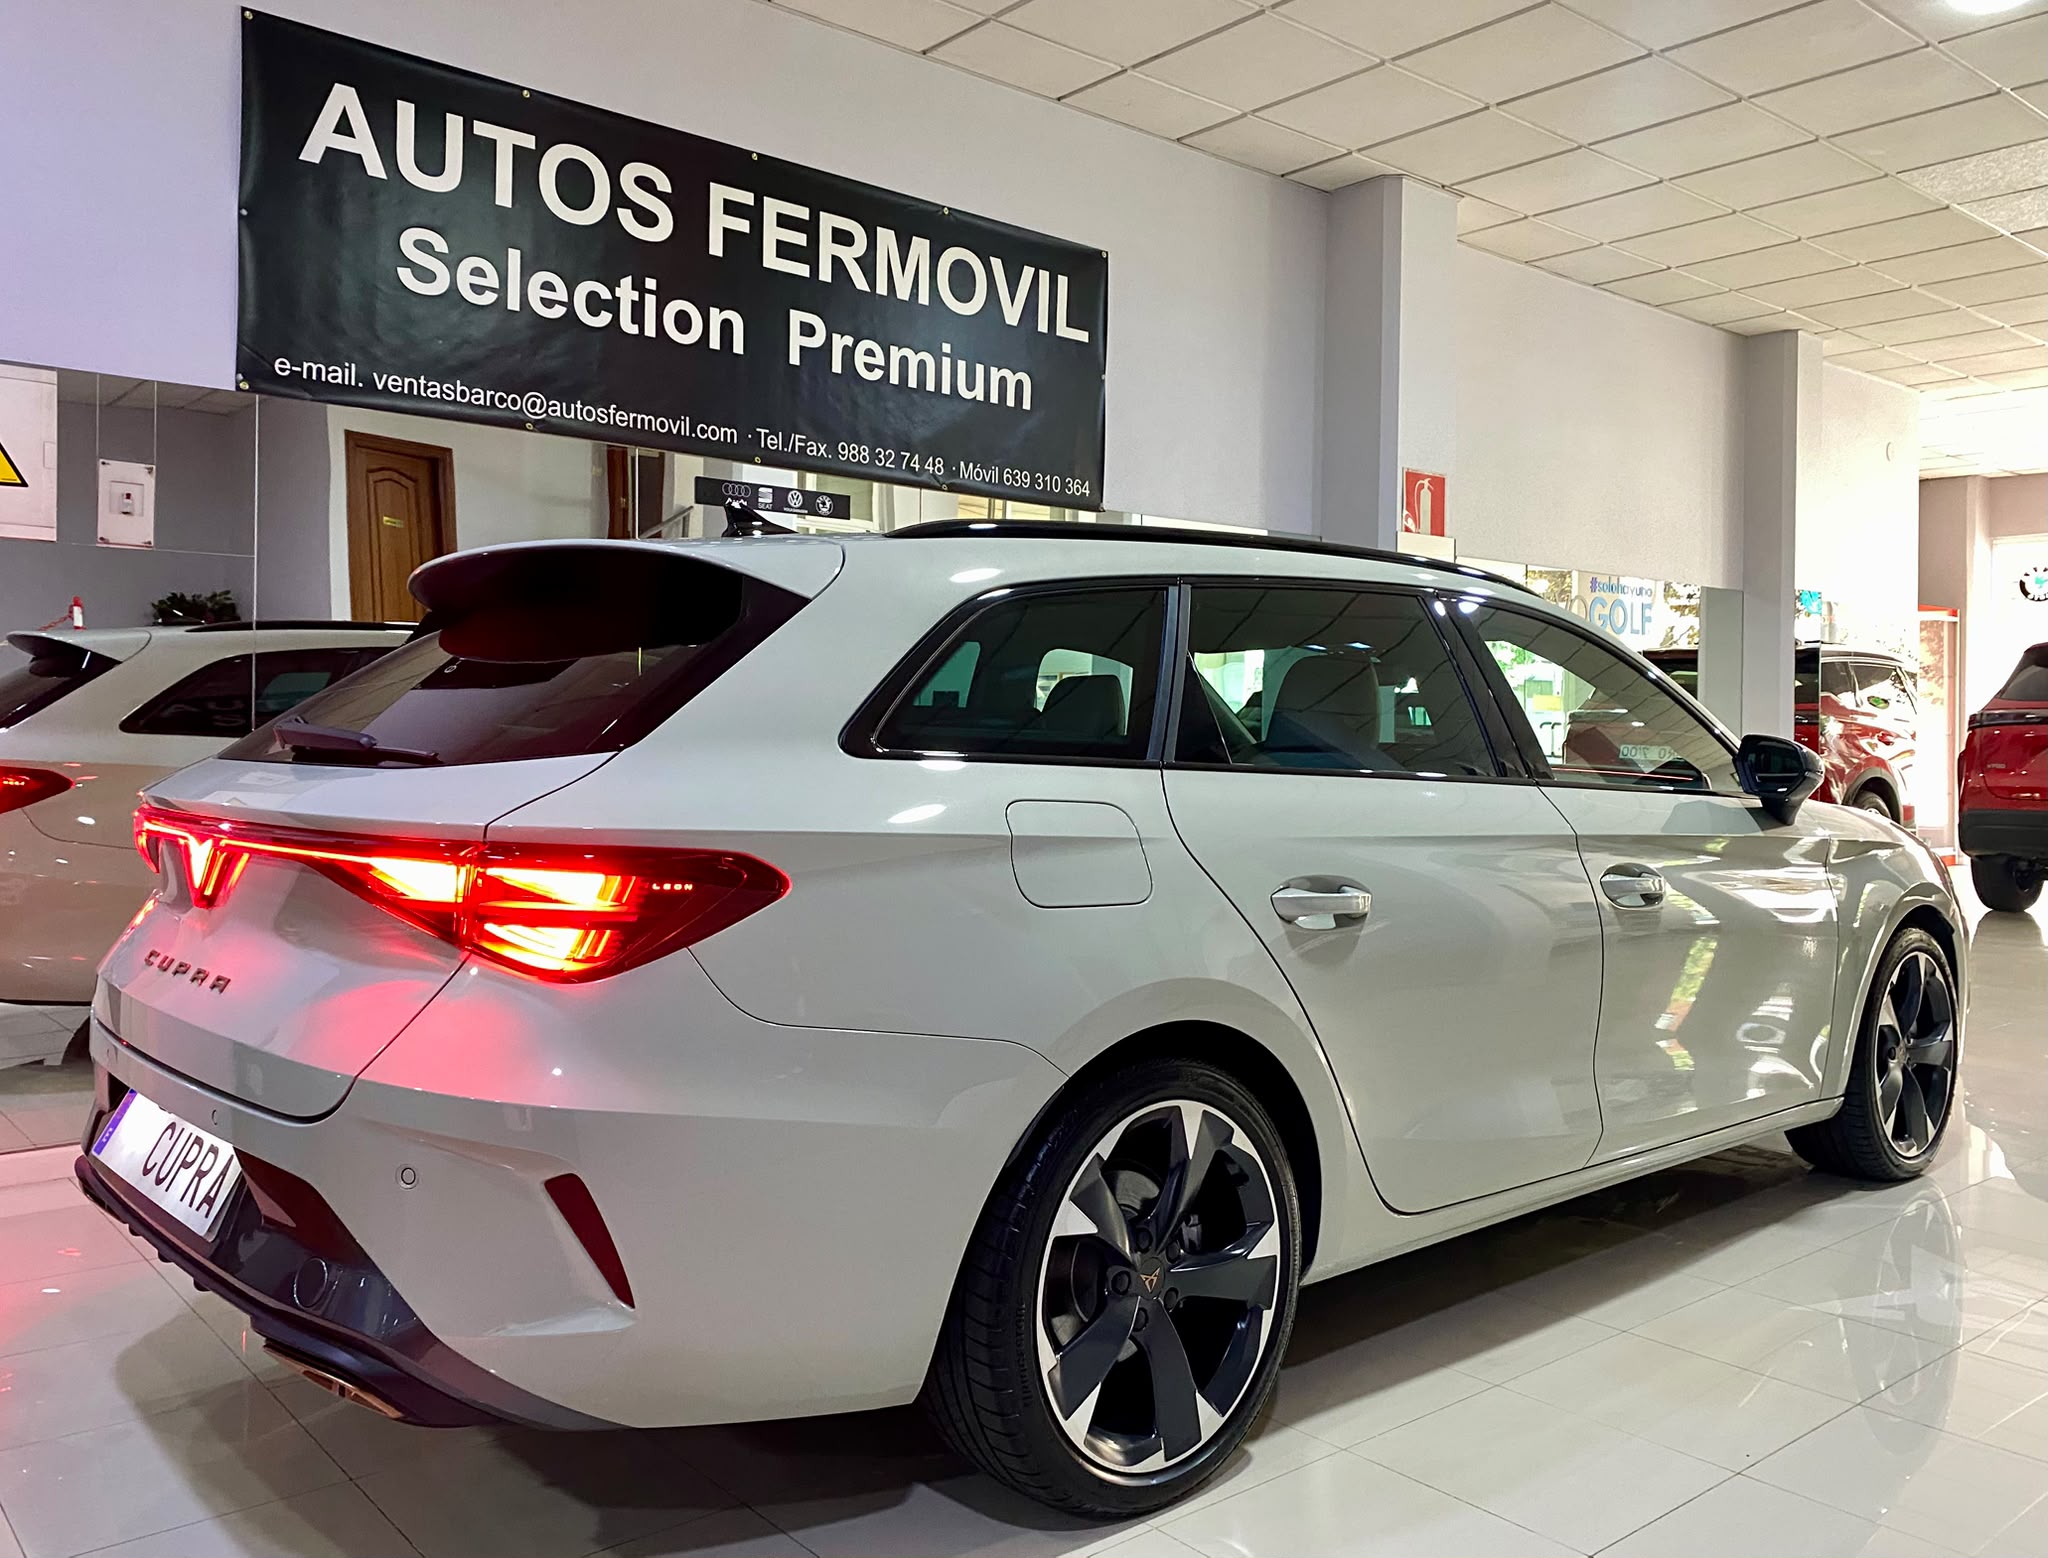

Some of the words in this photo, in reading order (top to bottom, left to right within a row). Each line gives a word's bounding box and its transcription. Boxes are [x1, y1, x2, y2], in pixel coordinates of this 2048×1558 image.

[298, 82, 675, 243] AUTOS
[708, 181, 1090, 344] FERMOVIL
[396, 226, 745, 355] Selection
[788, 308, 1032, 411] Premium
[274, 357, 363, 388] e-mail.
[372, 371, 738, 444] ventasbarco@autosfermovil.com
[755, 428, 832, 459] Tel./Fax.
[837, 441, 870, 464] 988
[874, 447, 896, 469] 32
[900, 451, 921, 472] 74
[924, 456, 945, 475] 48
[959, 460, 999, 484] Móvil
[1003, 467, 1031, 488] 639
[1034, 473, 1061, 493] 310
[1065, 477, 1090, 497] 364
[1589, 596, 1653, 635] GOLF
[143, 949, 232, 995] CUPRA
[141, 1121, 235, 1219] CUPRA
